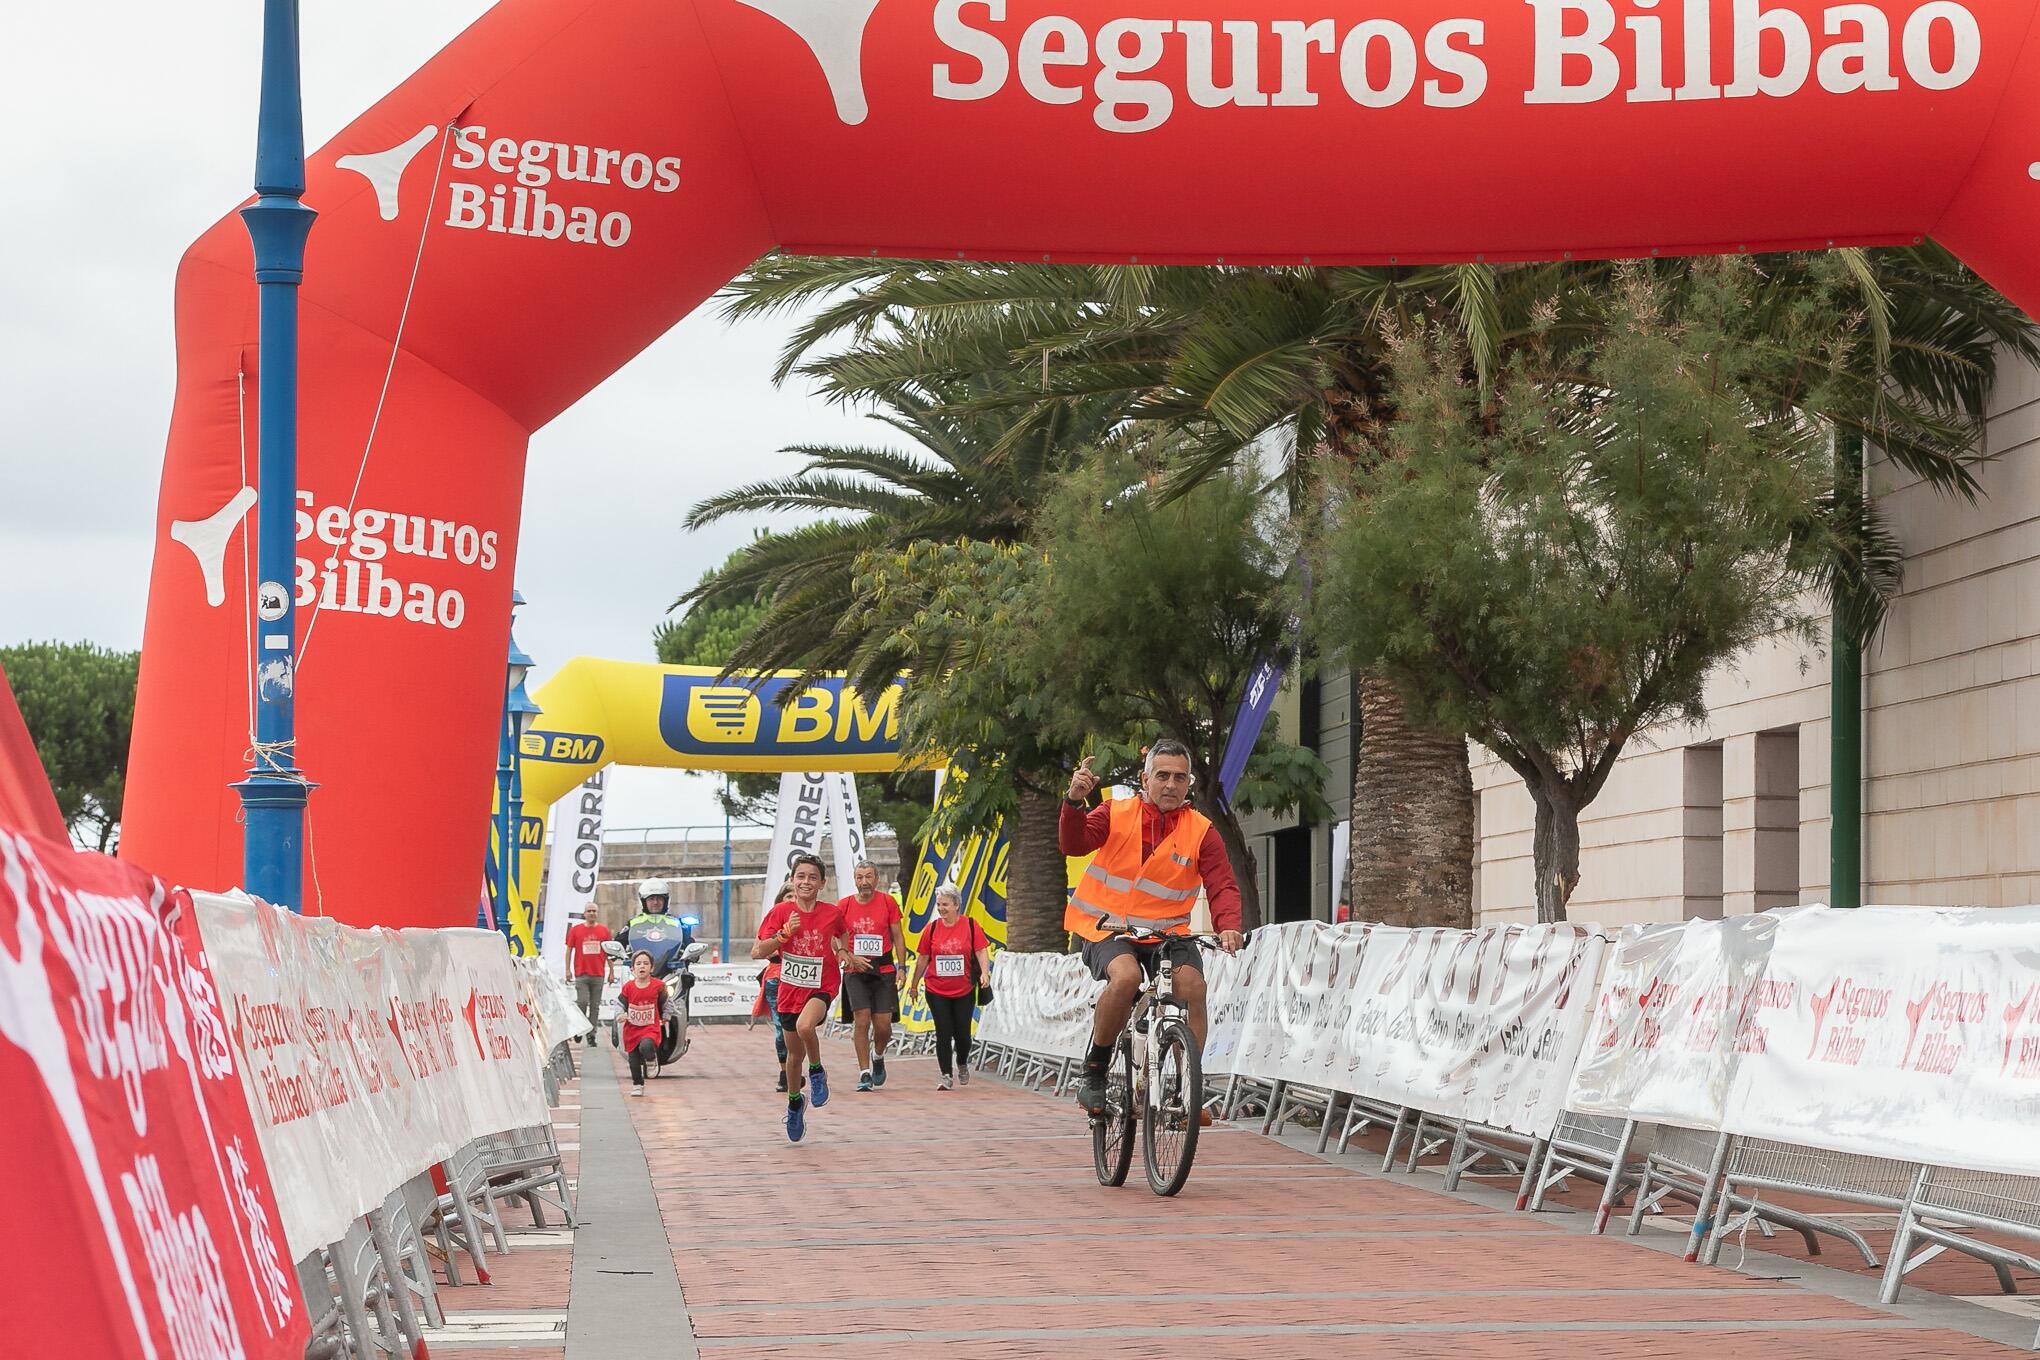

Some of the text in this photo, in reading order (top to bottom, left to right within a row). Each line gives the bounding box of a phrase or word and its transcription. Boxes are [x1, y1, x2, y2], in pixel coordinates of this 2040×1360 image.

[932, 0, 1982, 133] Seguros Bilbao
[452, 125, 682, 193] Seguros
[445, 182, 632, 248] Bilbao
[775, 684, 903, 744] BM
[550, 737, 598, 760] BM
[858, 940, 880, 952] 1003
[939, 961, 962, 972] 1003
[784, 961, 818, 980] 2054
[694, 995, 734, 1004] EL CORREO
[1836, 978, 1893, 1024] Seguros
[1931, 982, 1988, 1030] Seguros
[1821, 1026, 1866, 1066] Bilbao
[1914, 1033, 1962, 1074] Bilbao
